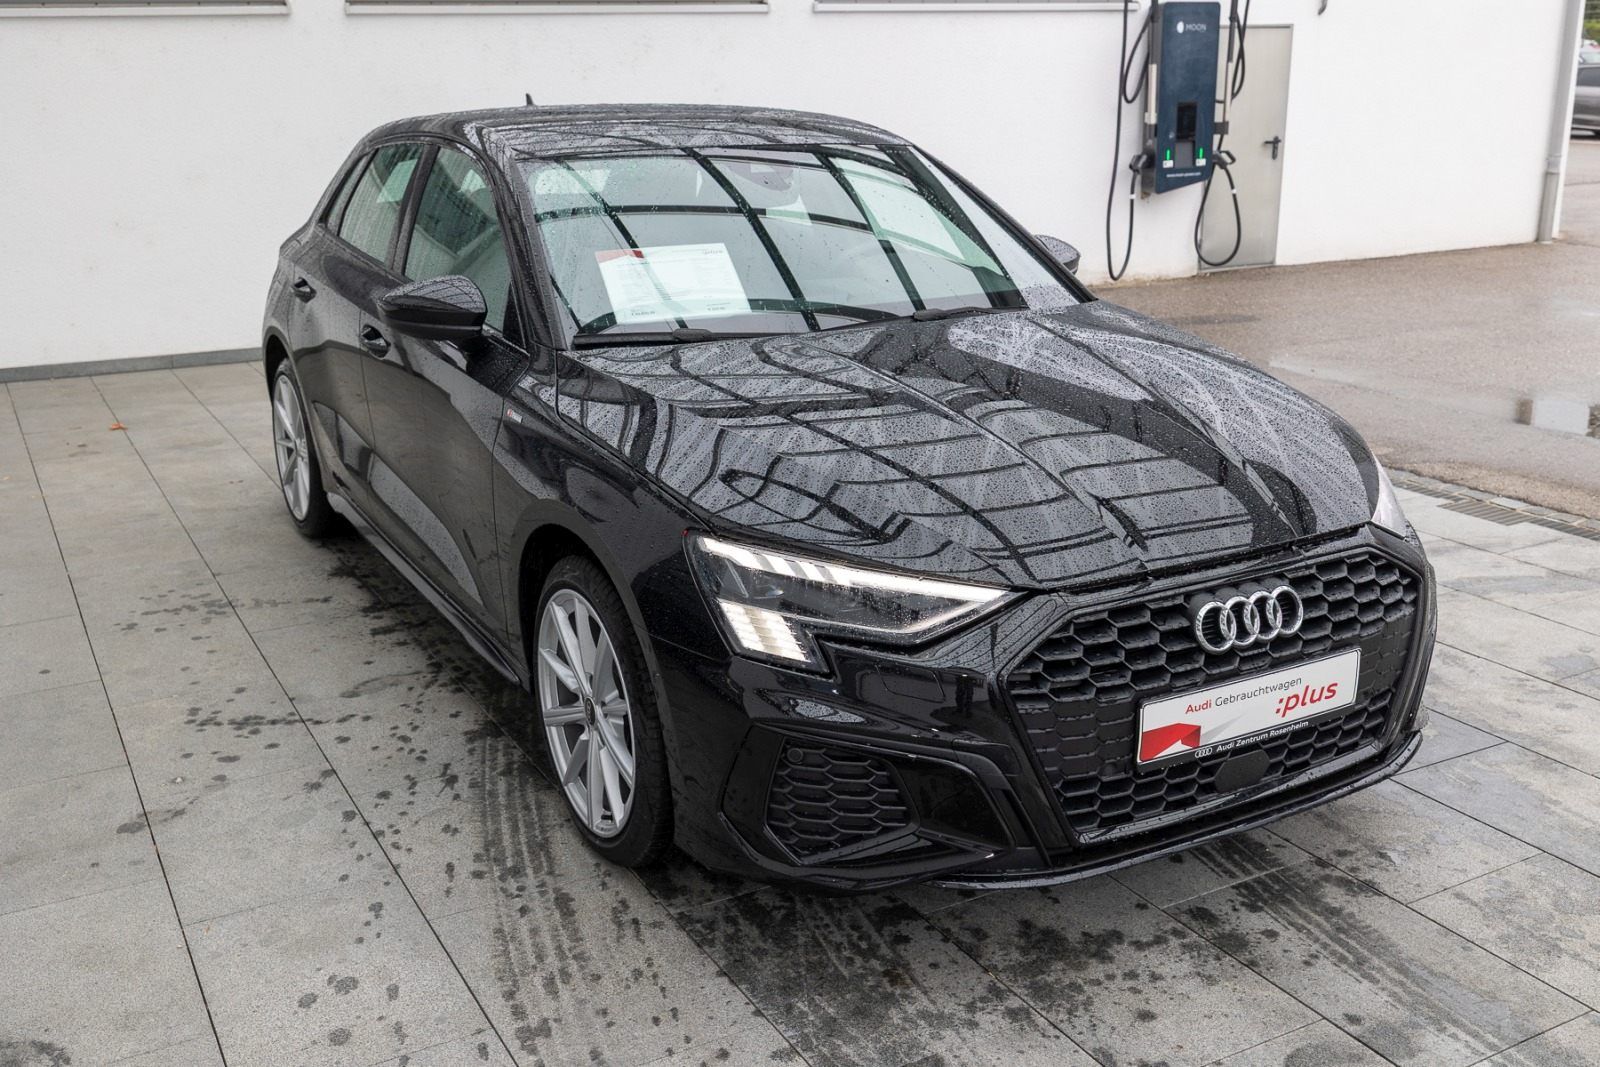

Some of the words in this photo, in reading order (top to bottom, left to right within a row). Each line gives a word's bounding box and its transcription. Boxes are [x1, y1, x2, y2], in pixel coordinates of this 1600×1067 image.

[1185, 23, 1206, 31] MOON
[1185, 699, 1212, 714] Audi
[1214, 677, 1302, 707] Gebrauchtwagen
[1216, 743, 1234, 752] Audi
[1235, 733, 1269, 747] Zentrum
[1269, 721, 1309, 737] Rosenheim
